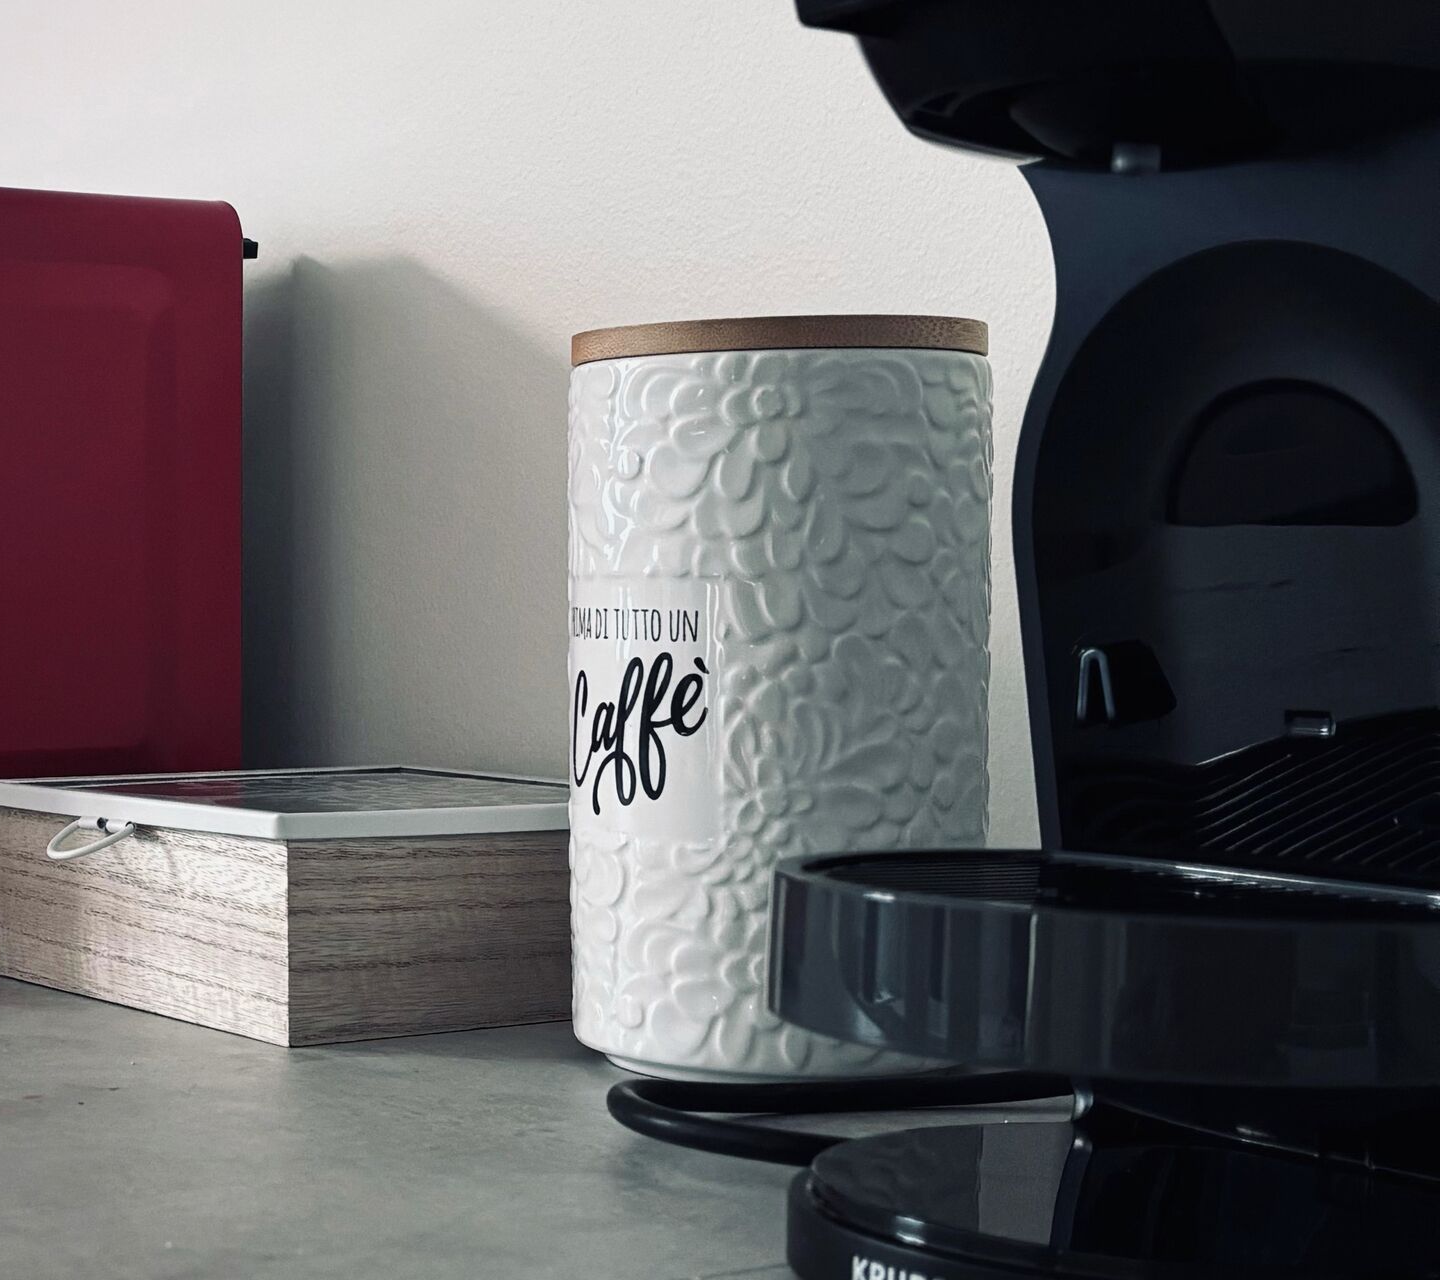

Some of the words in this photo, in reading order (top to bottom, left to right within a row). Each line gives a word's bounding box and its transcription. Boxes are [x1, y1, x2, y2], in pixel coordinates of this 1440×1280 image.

[595, 608, 609, 640] DI
[613, 608, 662, 642] TUTTO
[669, 609, 699, 643] UN
[573, 651, 710, 816] Caffè
